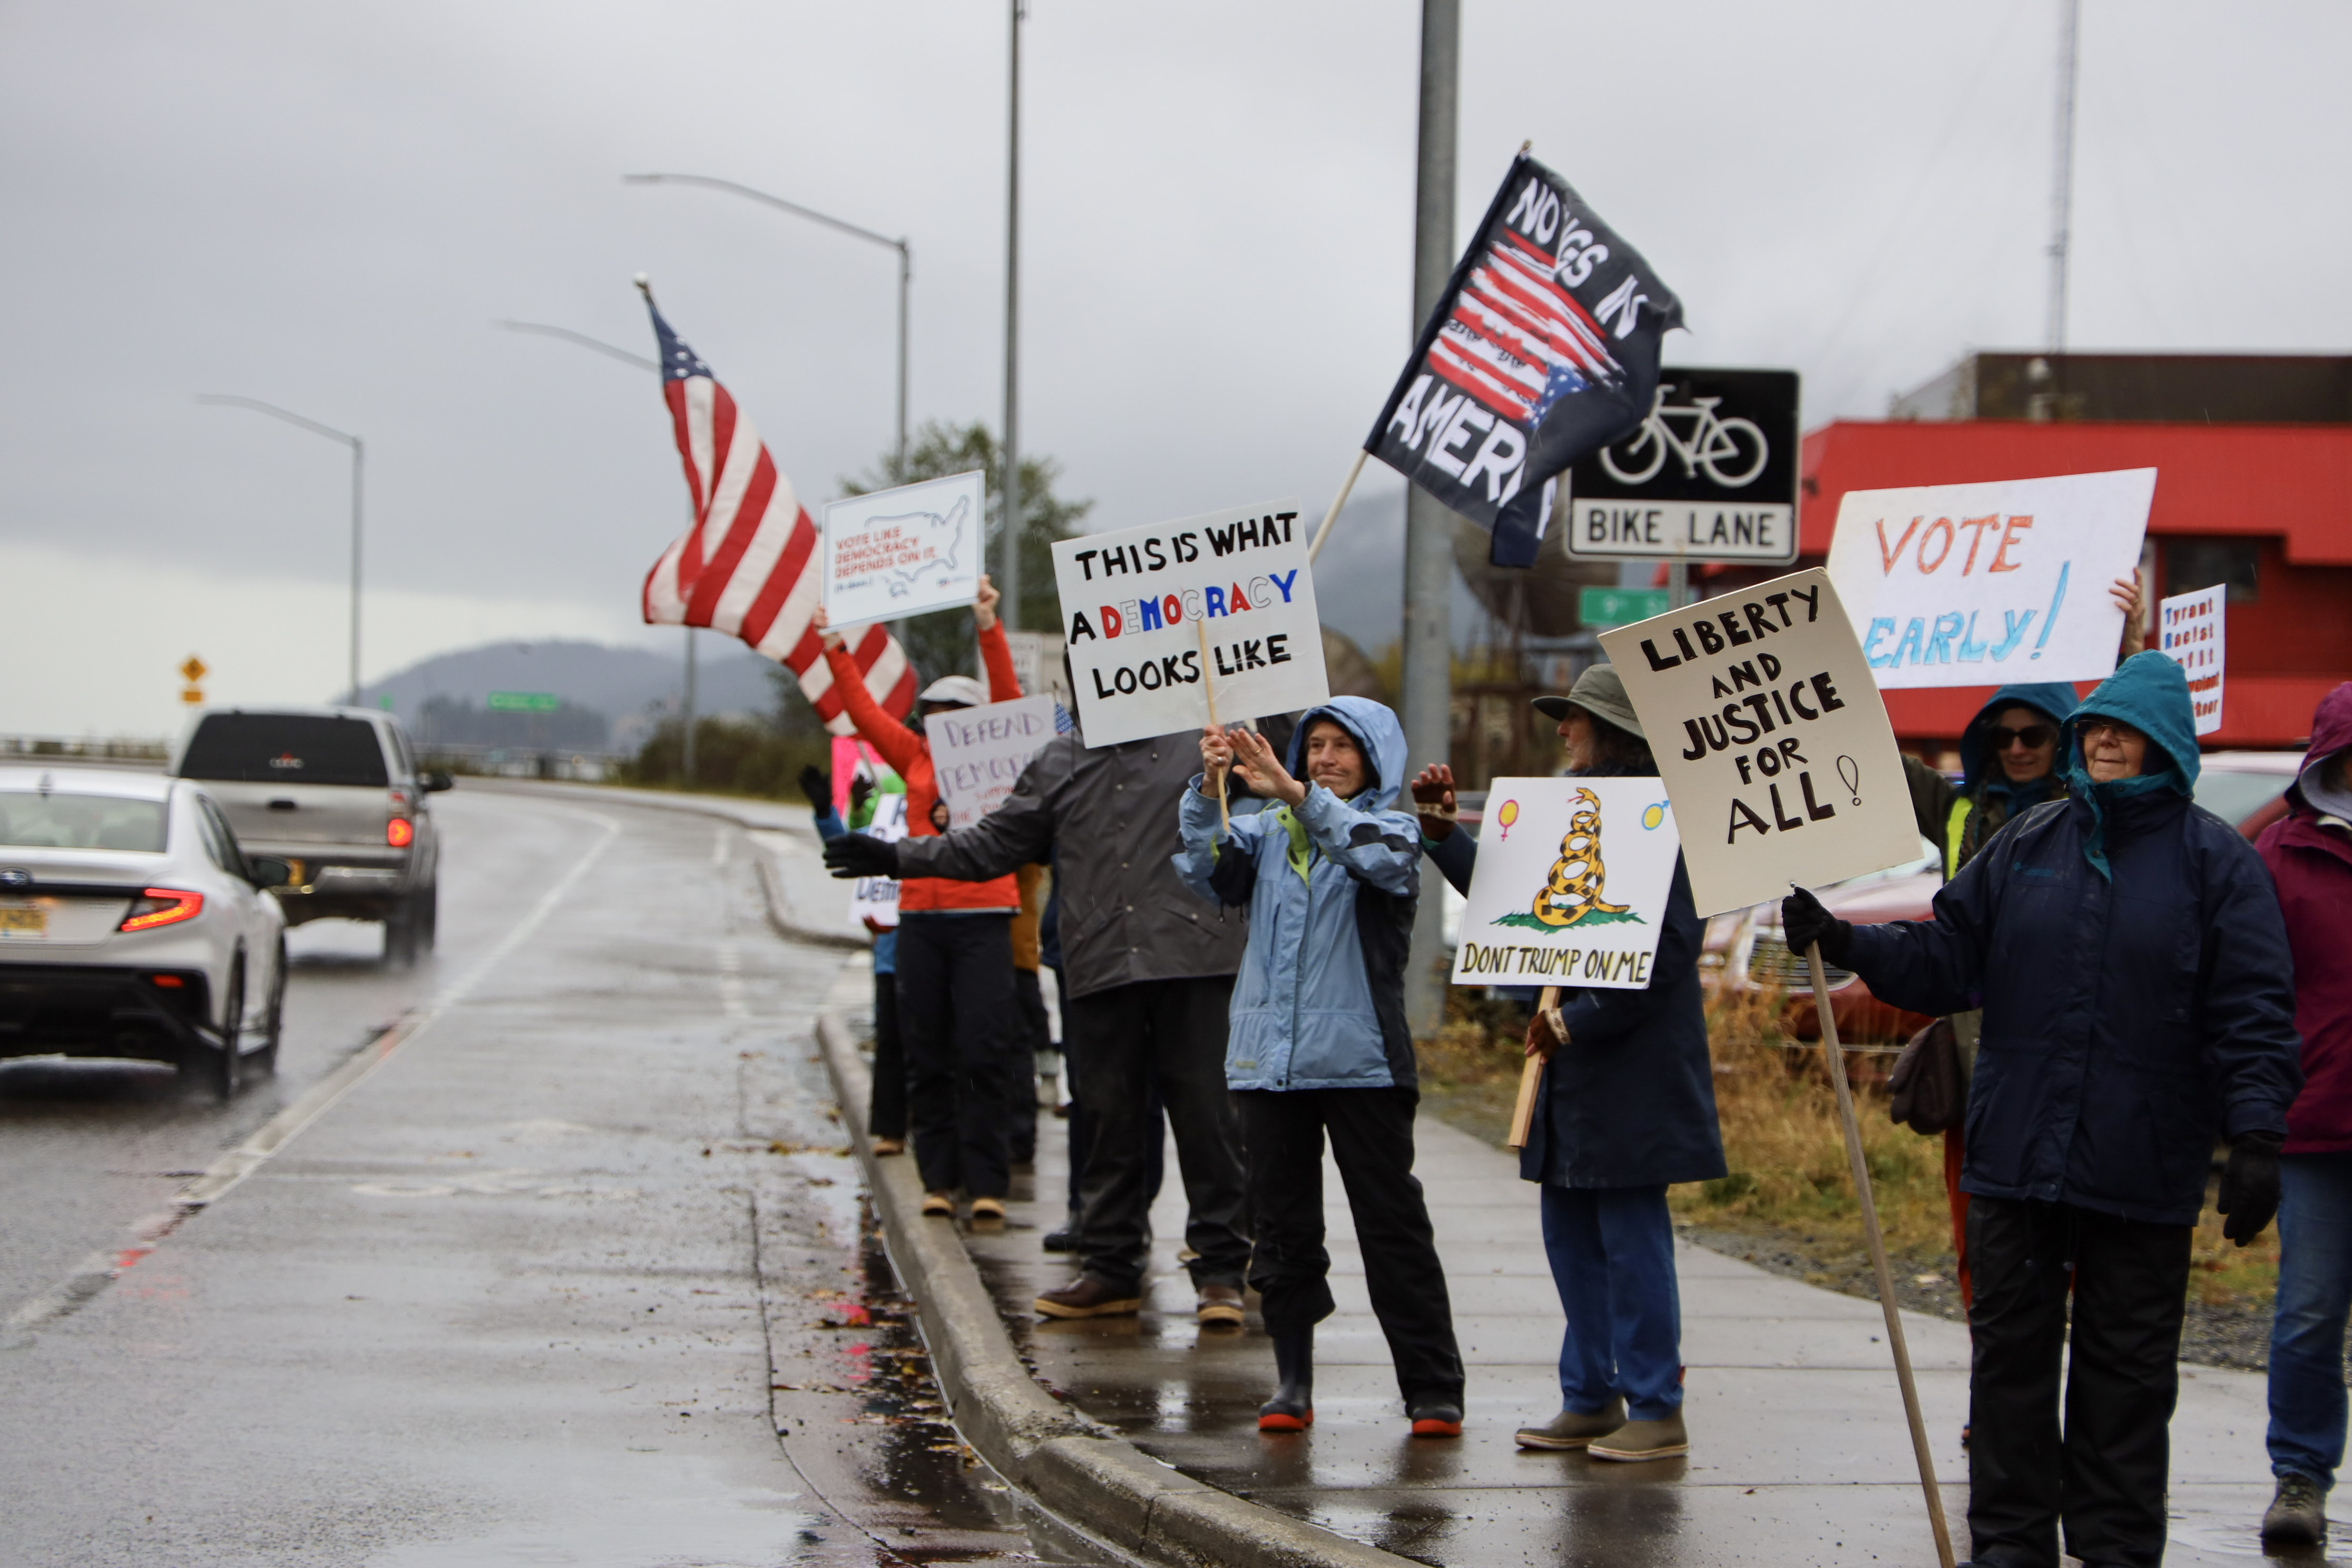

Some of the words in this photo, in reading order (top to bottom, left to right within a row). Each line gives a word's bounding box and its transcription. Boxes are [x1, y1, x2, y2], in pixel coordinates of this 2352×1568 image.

[1506, 177, 1560, 245] NO
[1386, 373, 1557, 541] AMERI
[835, 536, 920, 565] DEMOCRACY
[836, 534, 870, 550] VOTE
[874, 527, 902, 543] LIKE
[1075, 537, 1167, 580] THIS
[1171, 532, 1199, 563] IS
[1205, 512, 1298, 557] WHAT
[1589, 508, 1663, 544] BIKE
[1689, 512, 1776, 547] LANE
[1875, 512, 2034, 577] VOTE
[835, 556, 894, 580] DEPENDS
[898, 552, 922, 566] ON
[1070, 611, 1097, 645] A
[1099, 569, 1298, 640] DEMOCRACY
[1640, 584, 1819, 672] LIBERTY
[1863, 560, 2071, 669] EARLY!
[2165, 598, 2213, 625] Tyrant
[2165, 623, 2213, 650] Racist
[1092, 650, 1200, 699] LOOKS
[1214, 634, 1291, 676] LIKE
[1712, 653, 1781, 699] AND
[944, 712, 1045, 748] DEFEND
[1683, 671, 1846, 761] JUSTICE
[1735, 738, 1809, 785] FOR
[1518, 947, 1582, 977] TRUMP
[1584, 949, 1613, 981] ON
[1612, 952, 1653, 983] ME
